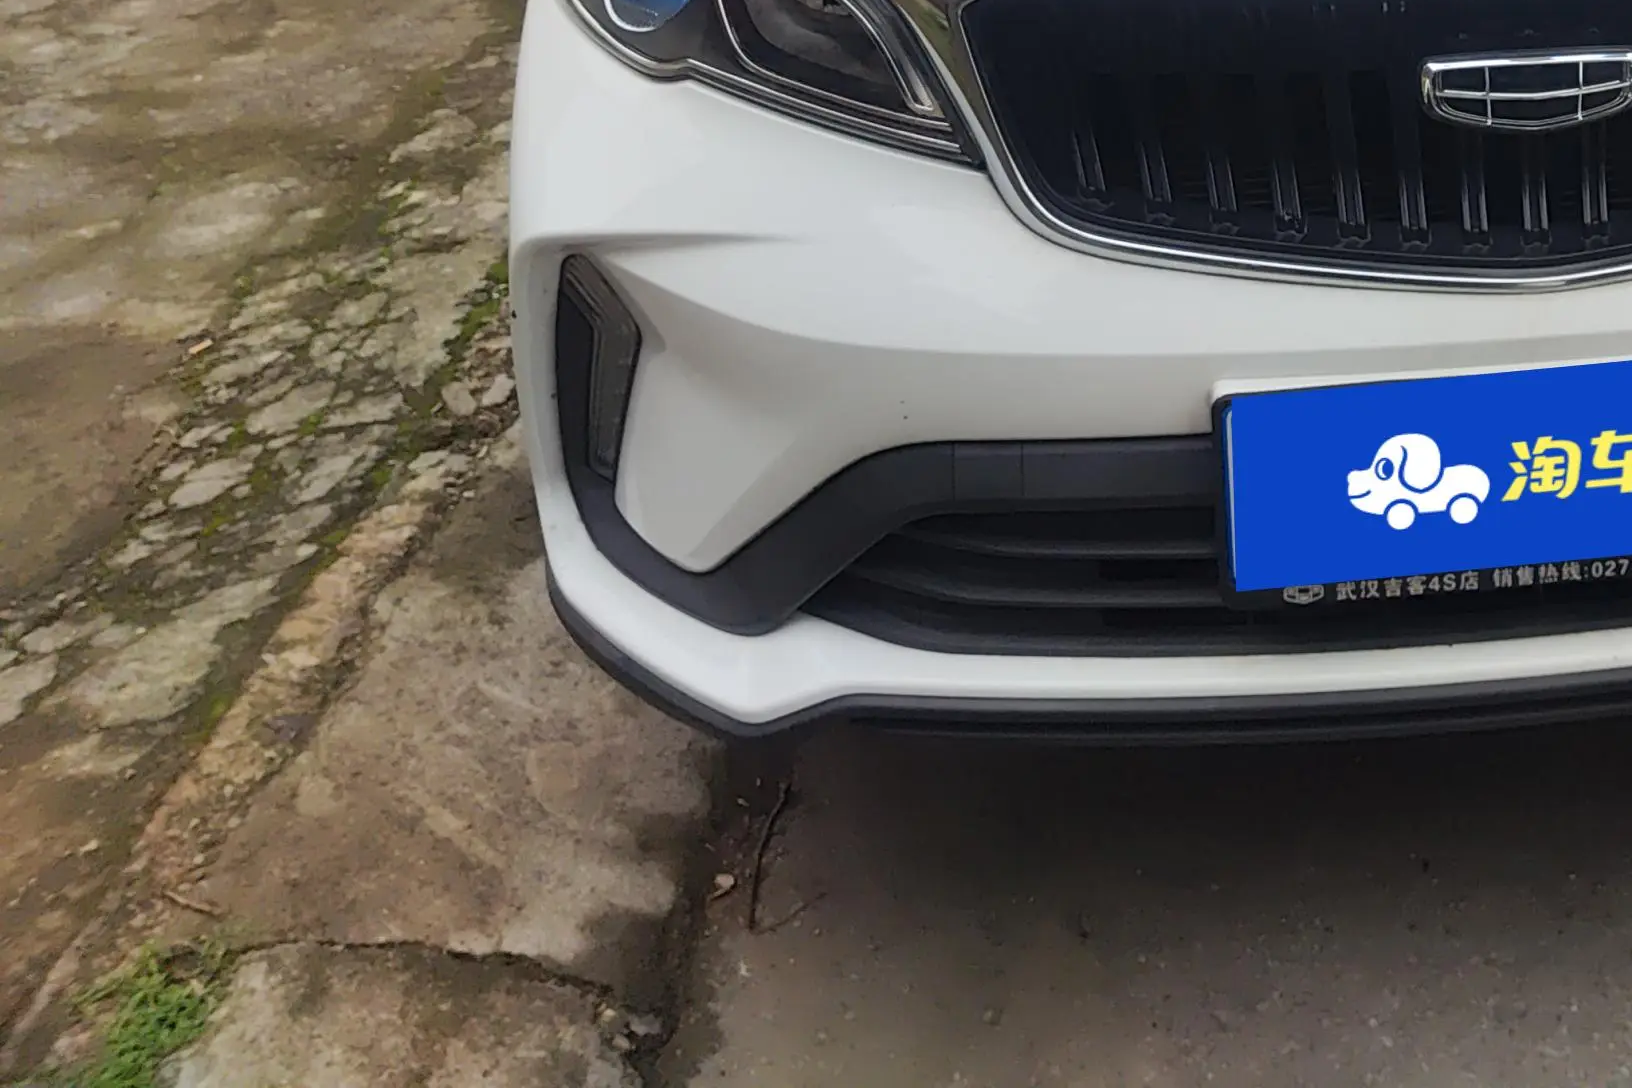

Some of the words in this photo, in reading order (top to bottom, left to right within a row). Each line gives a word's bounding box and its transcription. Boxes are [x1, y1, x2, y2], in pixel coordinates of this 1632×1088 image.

[1335, 570, 1480, 601] 武汉吉客4S店
